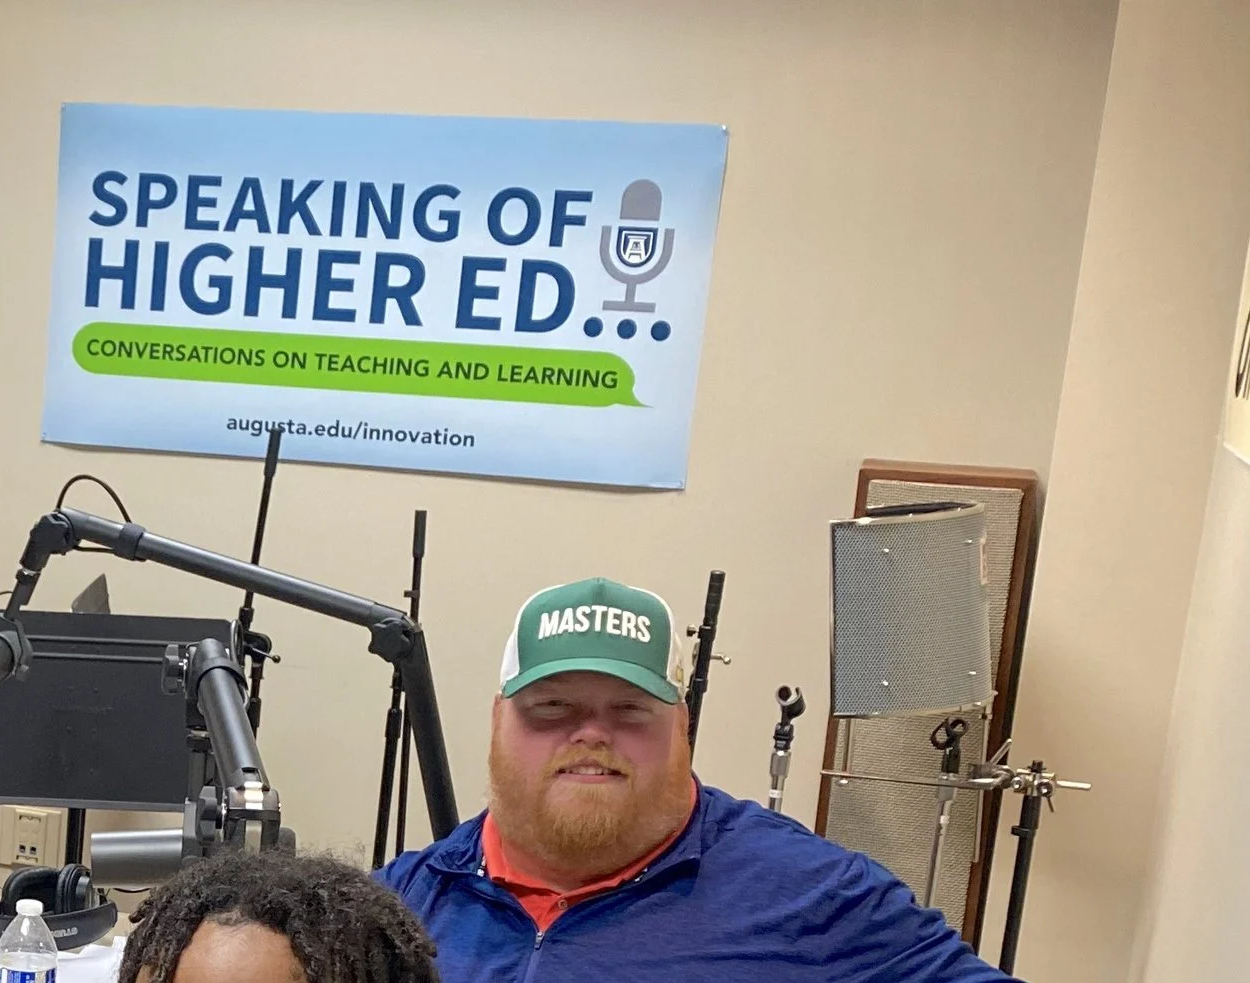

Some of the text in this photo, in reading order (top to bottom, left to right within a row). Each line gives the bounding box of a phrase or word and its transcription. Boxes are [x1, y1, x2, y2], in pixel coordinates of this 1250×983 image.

[89, 170, 593, 248] SPEAKING OF
[85, 237, 671, 342] HIGHER ED...
[86, 338, 619, 389] CONVERSATIONS ON TEACHING AND LEARNING
[226, 417, 475, 447] augusta.edu/innovation
[538, 605, 651, 643] MASTERS
